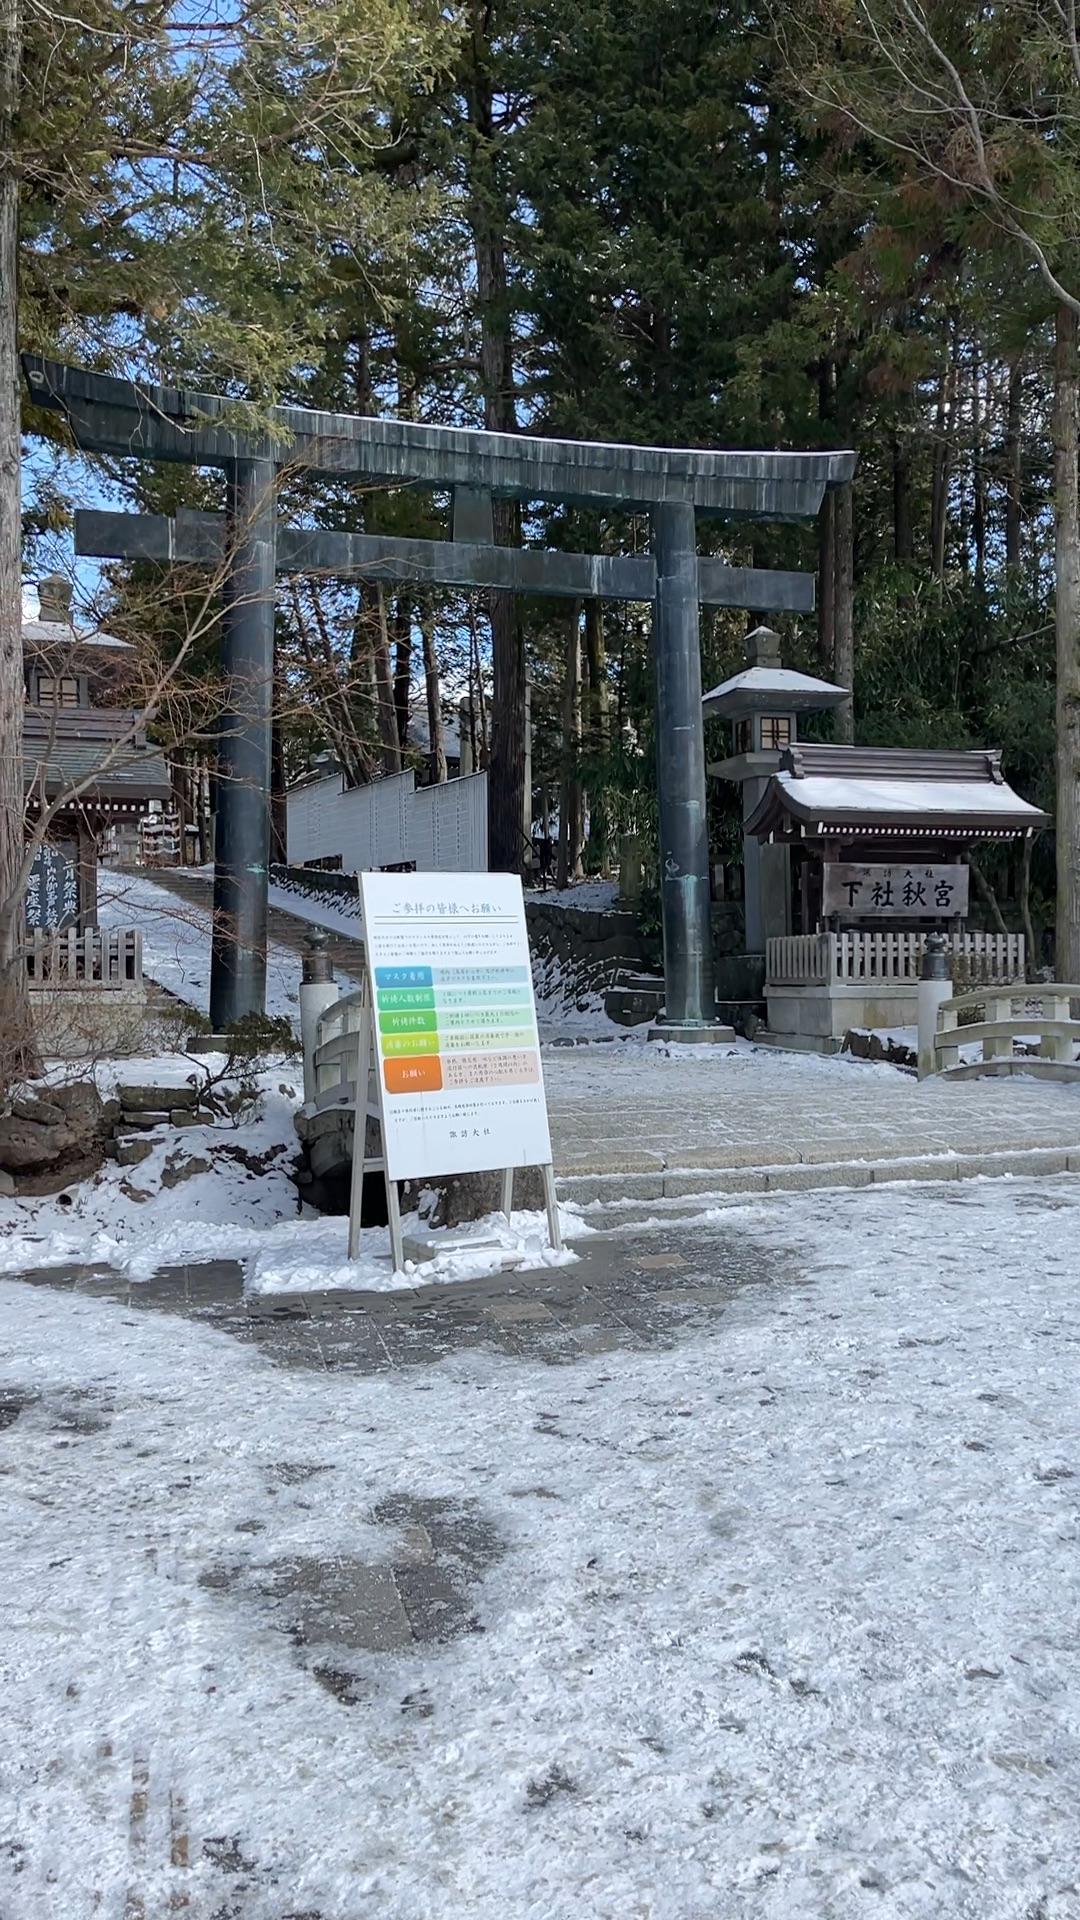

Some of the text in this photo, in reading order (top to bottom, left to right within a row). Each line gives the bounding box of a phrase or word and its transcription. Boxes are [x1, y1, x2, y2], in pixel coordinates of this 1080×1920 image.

[841, 880, 954, 908] 下社秋宮
[392, 902, 502, 915] ご参拝の皆様へお願い
[384, 971, 425, 982] マスク着用
[401, 1068, 426, 1079] お願い
